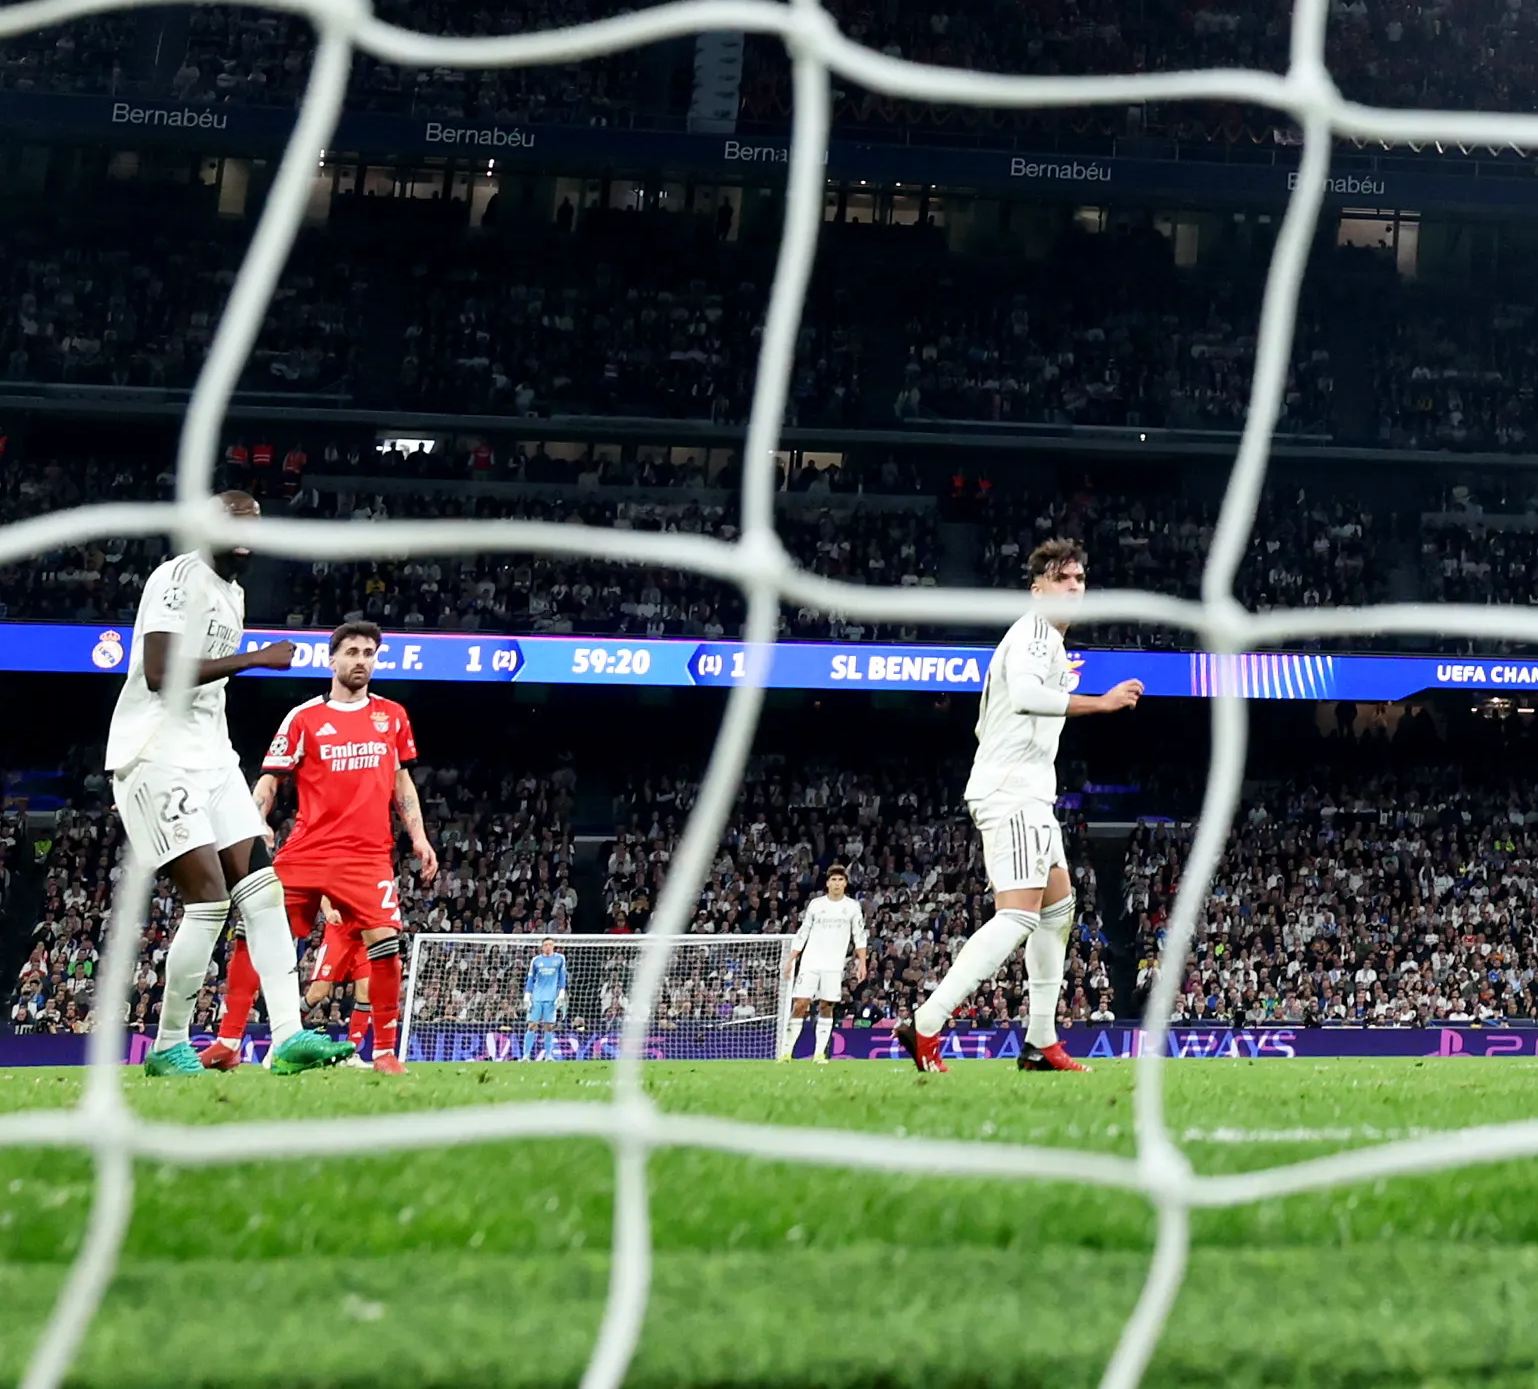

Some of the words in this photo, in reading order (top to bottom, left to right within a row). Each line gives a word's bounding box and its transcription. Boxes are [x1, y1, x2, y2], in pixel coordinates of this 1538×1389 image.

[111, 102, 228, 131] Bernabéu
[425, 122, 536, 149] Bernabéu
[724, 141, 829, 166] Berna
[1010, 157, 1112, 182] Bernabéu
[1287, 172, 1385, 195] Bnabéu
[207, 619, 239, 642] Emira
[402, 645, 423, 671] F.
[466, 646, 482, 672] 1
[492, 648, 517, 672] (2)
[572, 647, 651, 675] 59:20
[698, 653, 723, 677] (1)
[730, 652, 747, 678] 1
[831, 654, 863, 681] SL
[868, 655, 981, 683] BENFICA
[1437, 664, 1487, 684] UEFA
[320, 741, 388, 760] Emirates
[331, 759, 347, 772] FLY
[349, 755, 380, 771] BETTER
[153, 786, 198, 823] 22
[1029, 824, 1050, 856] 17
[377, 880, 397, 909] 2
